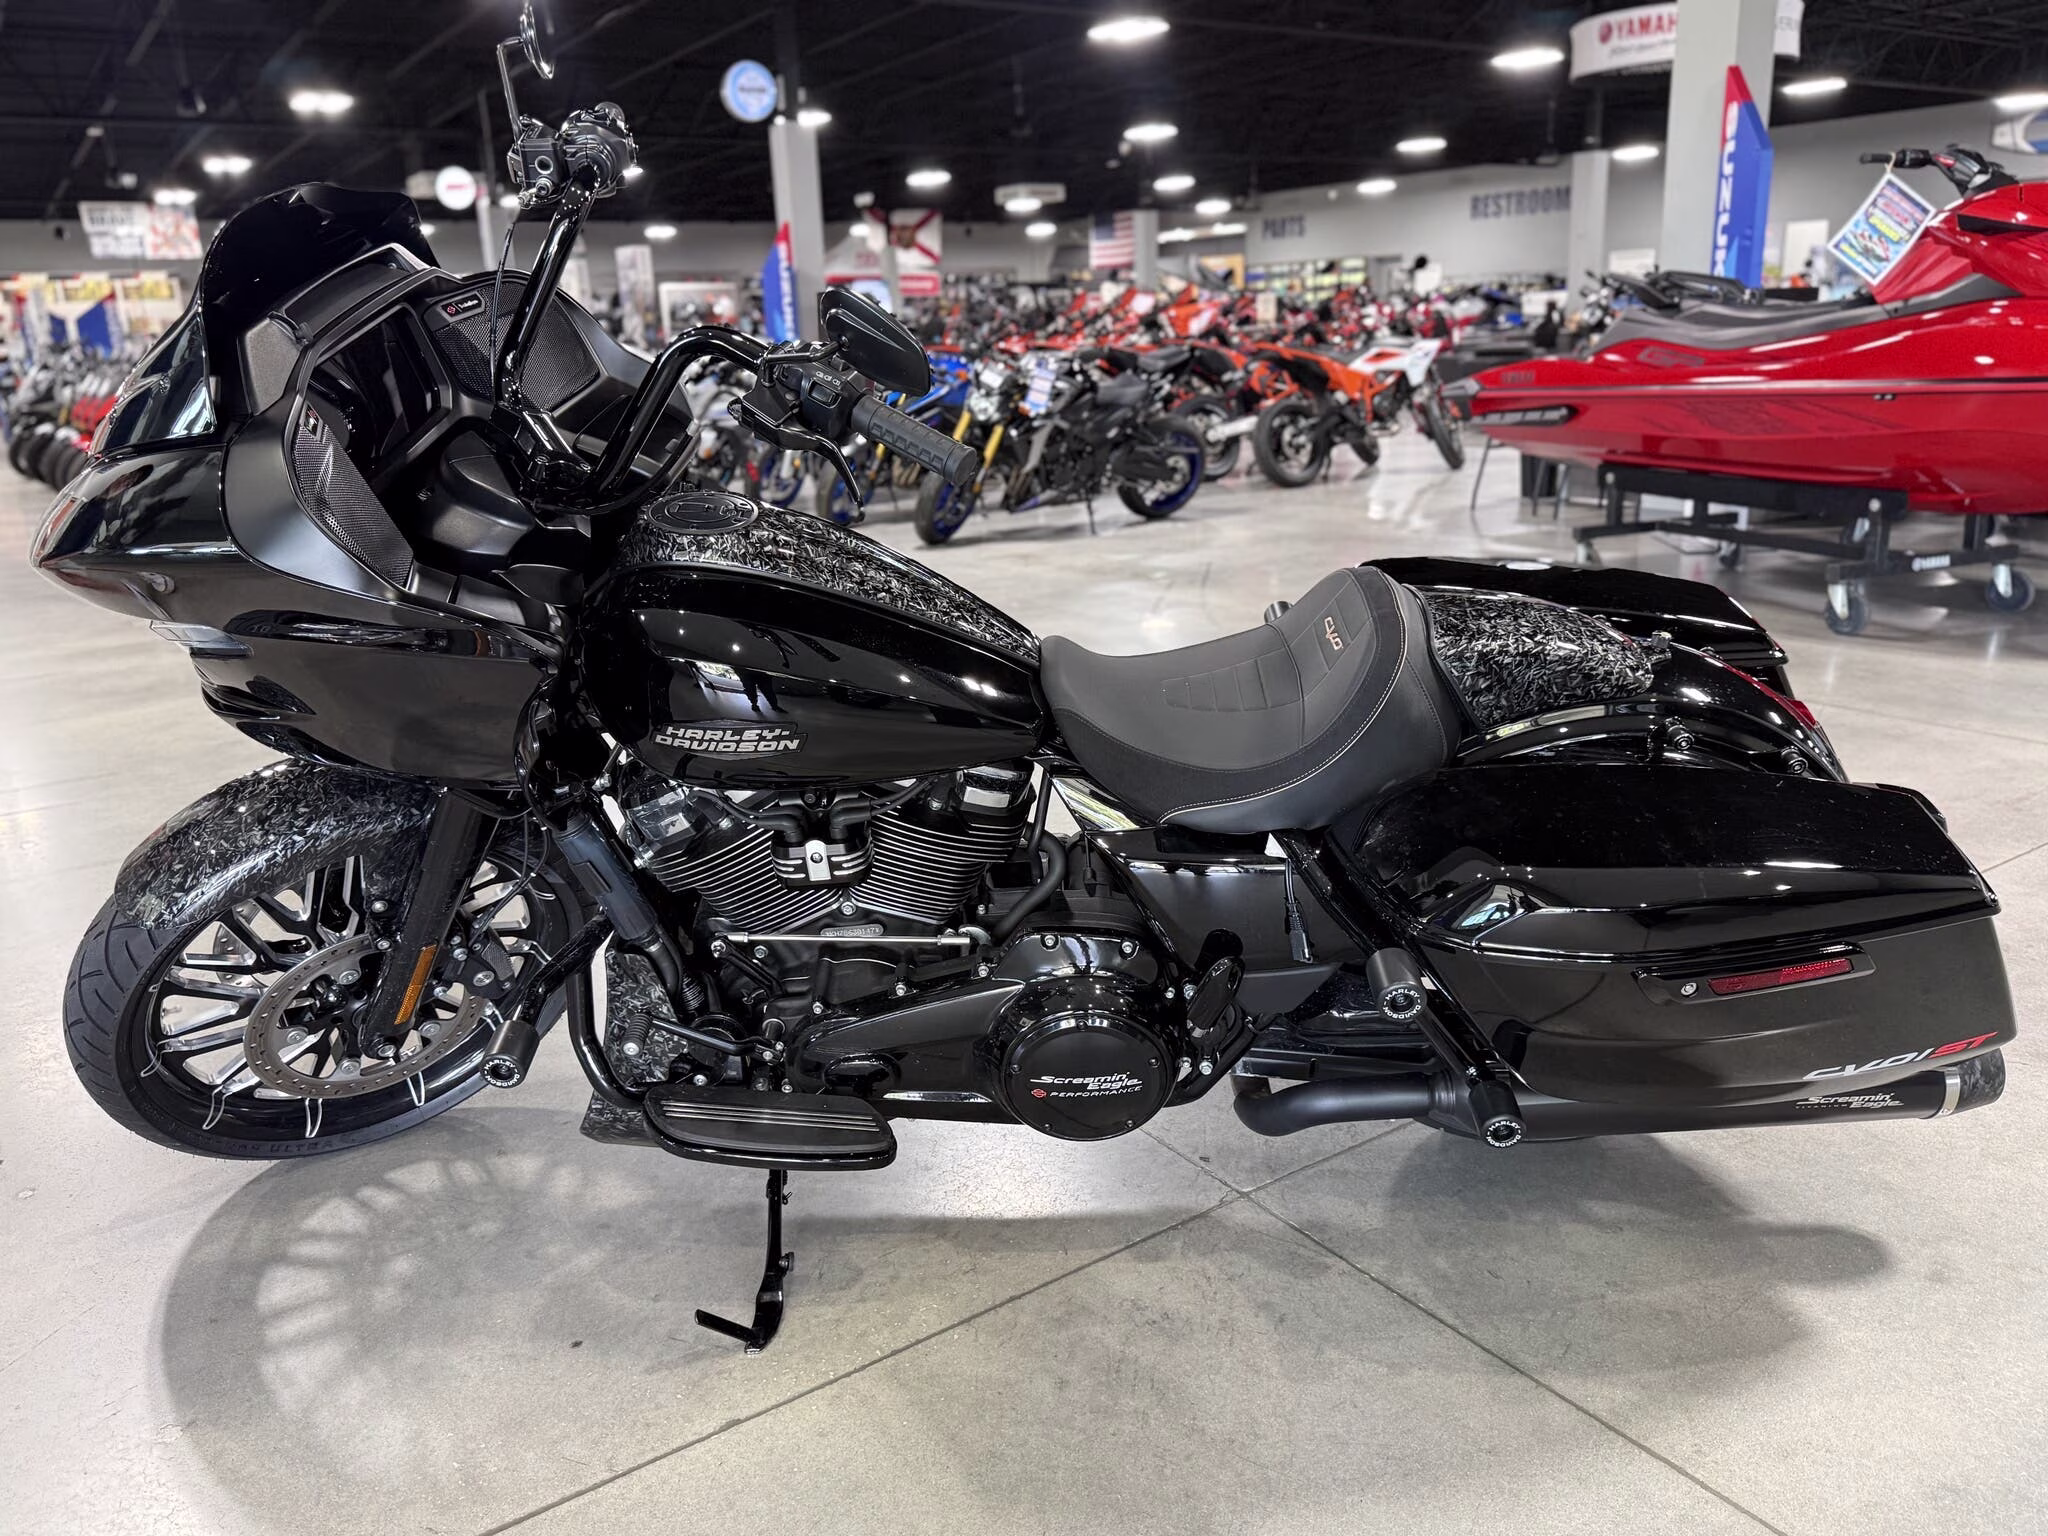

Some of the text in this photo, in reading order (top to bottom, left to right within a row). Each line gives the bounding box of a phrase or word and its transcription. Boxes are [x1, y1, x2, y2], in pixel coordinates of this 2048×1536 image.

[1615, 13, 1678, 42] YAMAH
[1714, 100, 1740, 277] SUZUK
[1261, 214, 1306, 240] PARTS
[665, 726, 790, 741] HARLEY-
[655, 734, 801, 752] DAVIDSON
[1050, 1085, 1142, 1098] PERFORMANCE
[1087, 1078, 1142, 1090] Eagle
[1849, 1098, 1905, 1109] Eagle
